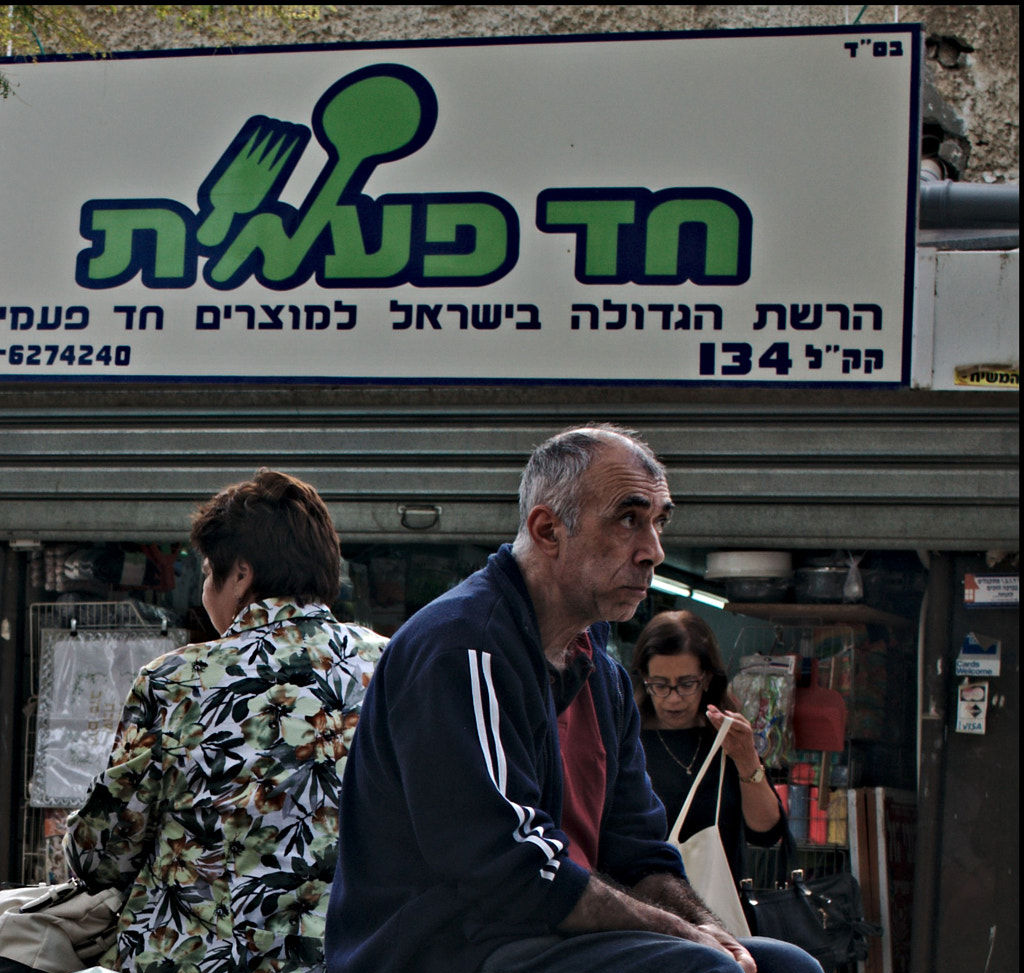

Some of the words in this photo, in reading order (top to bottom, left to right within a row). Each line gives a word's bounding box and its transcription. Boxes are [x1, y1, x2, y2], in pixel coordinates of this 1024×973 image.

[536, 186, 753, 286] חד
[113, 305, 164, 331] חד
[195, 300, 358, 331] למוצרים
[389, 299, 542, 331] בישראל
[571, 299, 723, 331] הגדולה
[753, 303, 883, 331] הרשת
[699, 341, 793, 376] 134
[969, 371, 1020, 385] המשיח
[955, 667, 993, 675] Welcome
[963, 722, 982, 731] VISA
